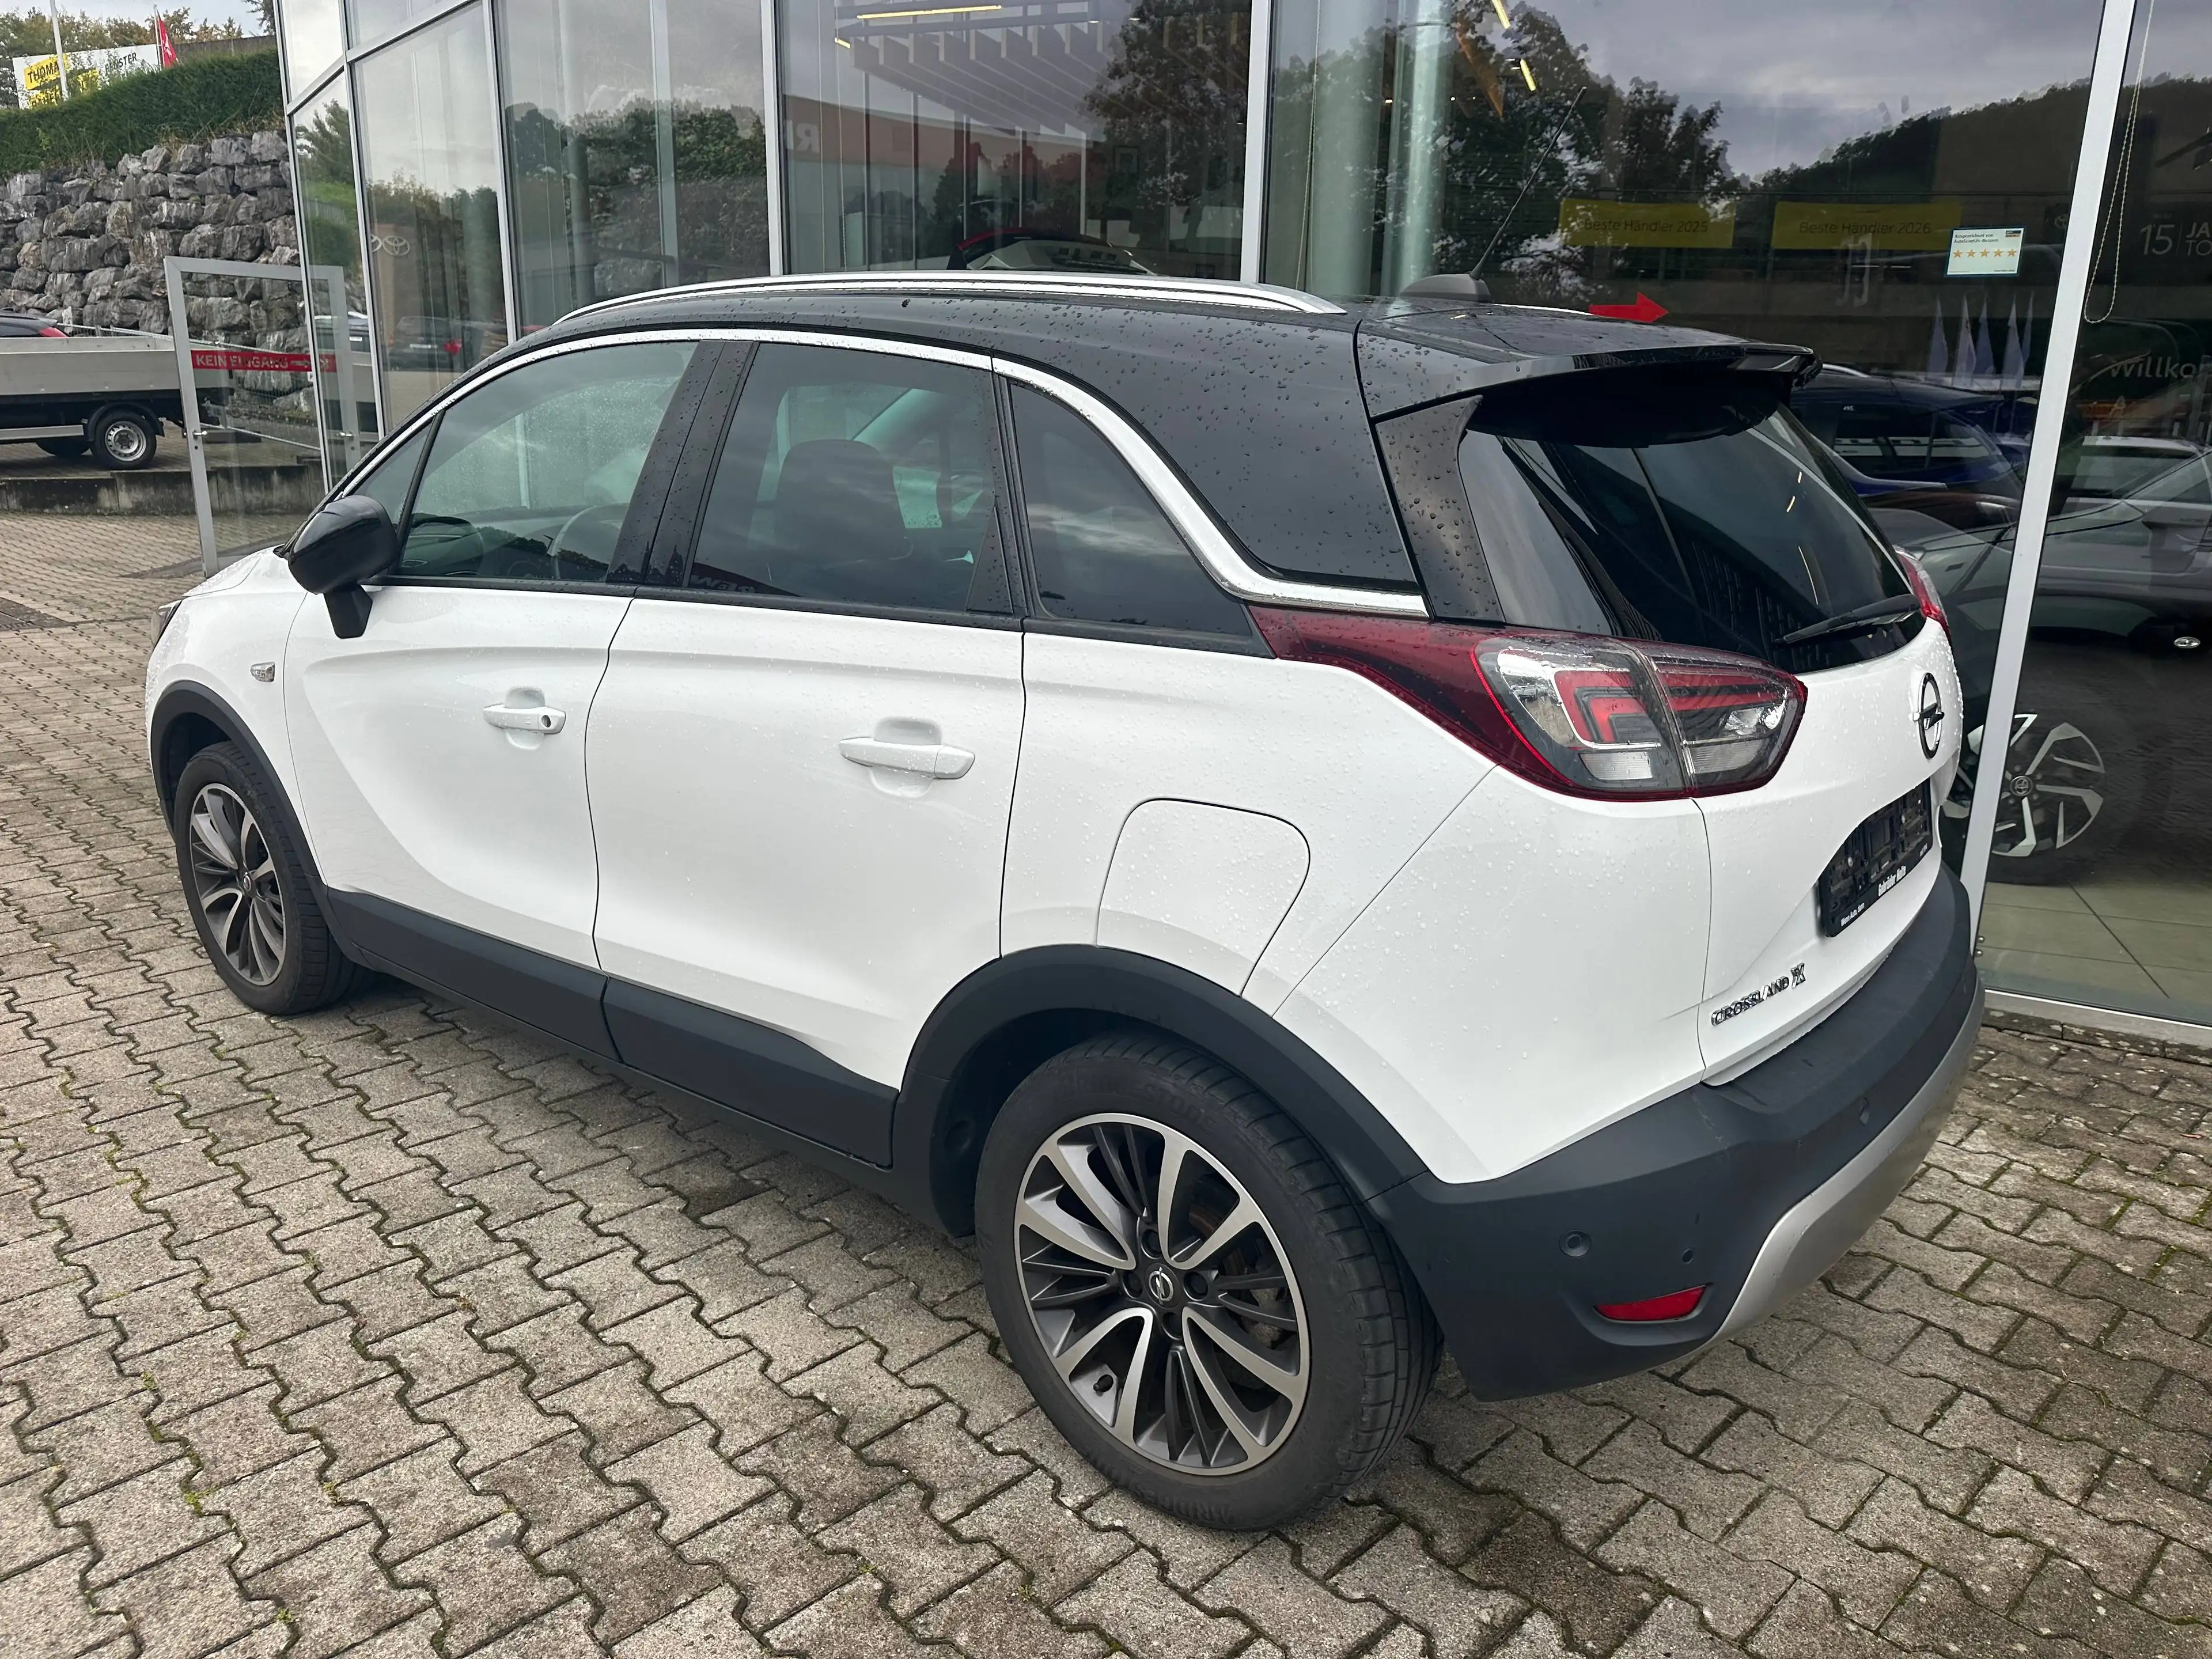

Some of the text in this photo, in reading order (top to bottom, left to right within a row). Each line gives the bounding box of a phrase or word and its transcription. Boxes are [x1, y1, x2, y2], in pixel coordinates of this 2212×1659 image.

[27, 60, 60, 84] THOMA
[1585, 219, 1709, 233] Beste Händler 2025
[1800, 222, 1931, 234] Beste Händler 2026
[2141, 223, 2176, 256] 15
[196, 354, 227, 367] KEIN
[1711, 962, 1806, 1026] CROSSLAND X
